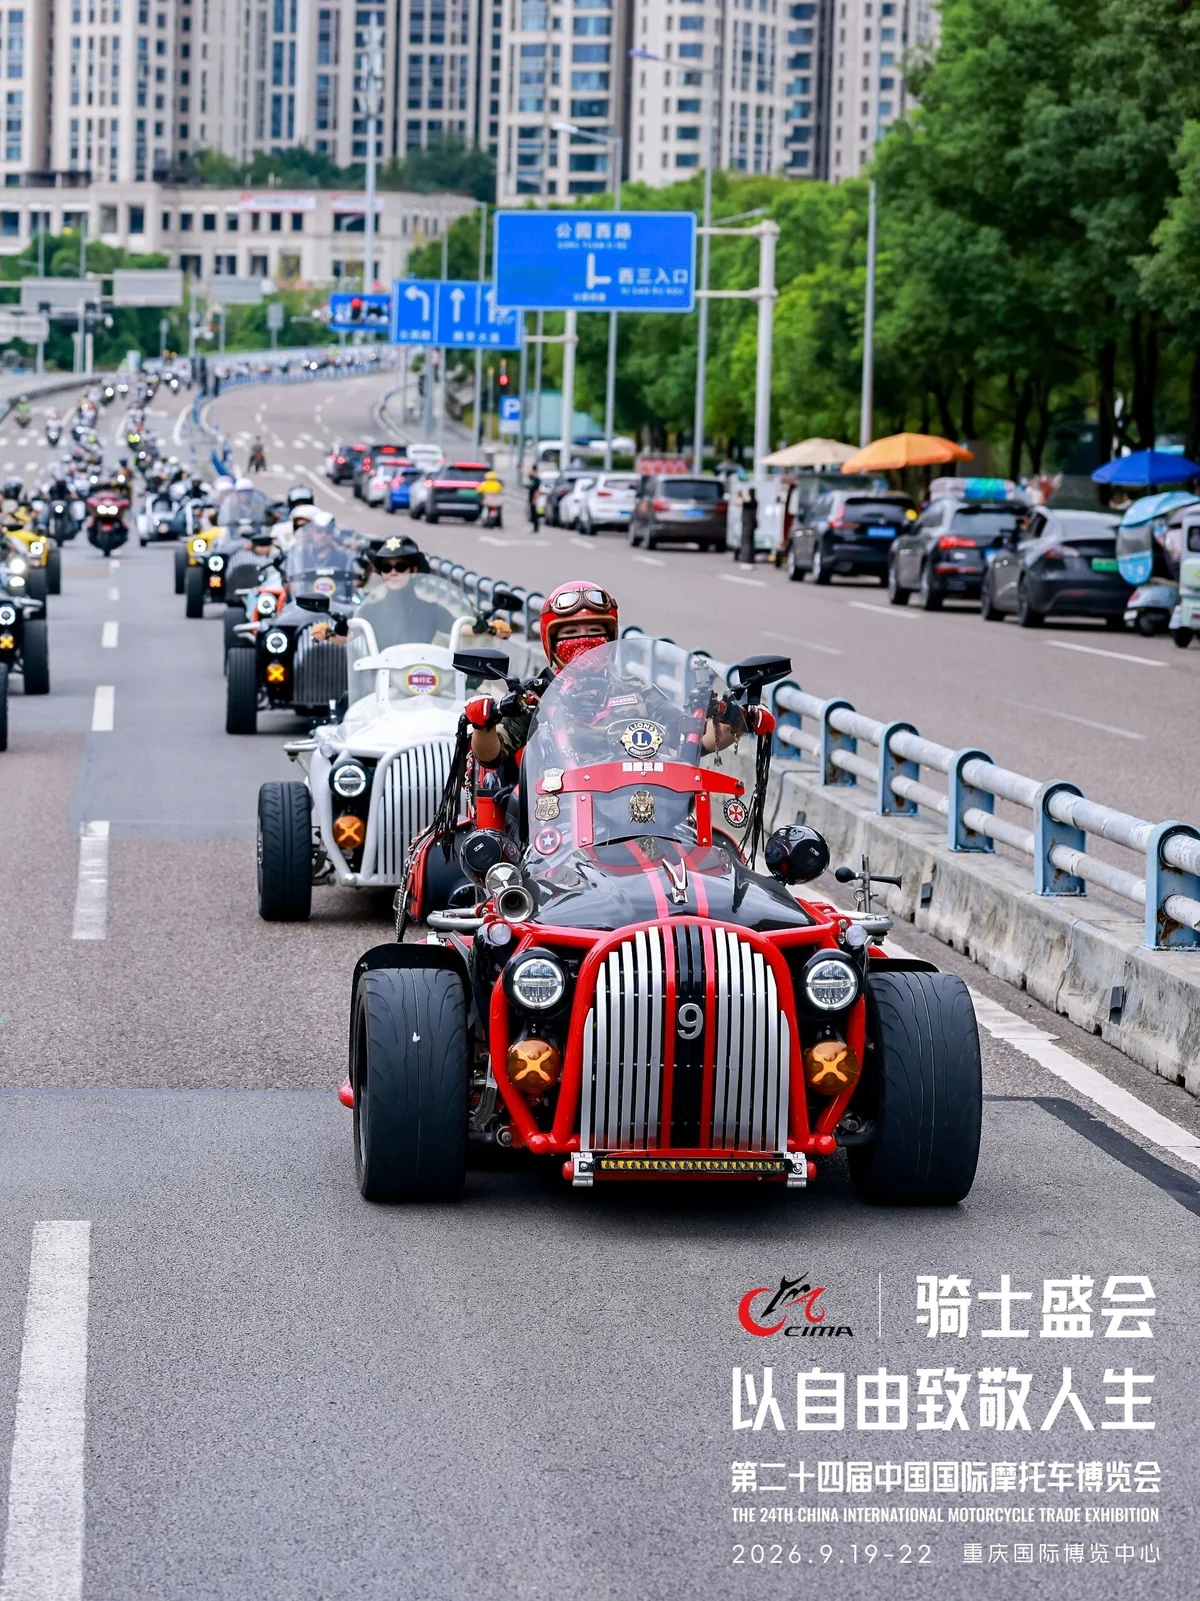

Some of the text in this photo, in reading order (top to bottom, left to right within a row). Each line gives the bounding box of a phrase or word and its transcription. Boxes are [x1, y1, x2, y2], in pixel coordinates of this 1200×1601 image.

[618, 267, 688, 285] 西三入口
[504, 398, 520, 418] P
[629, 722, 655, 731] LIONS
[636, 731, 648, 746] L
[540, 804, 555, 817] 66
[678, 1002, 704, 1040] 9
